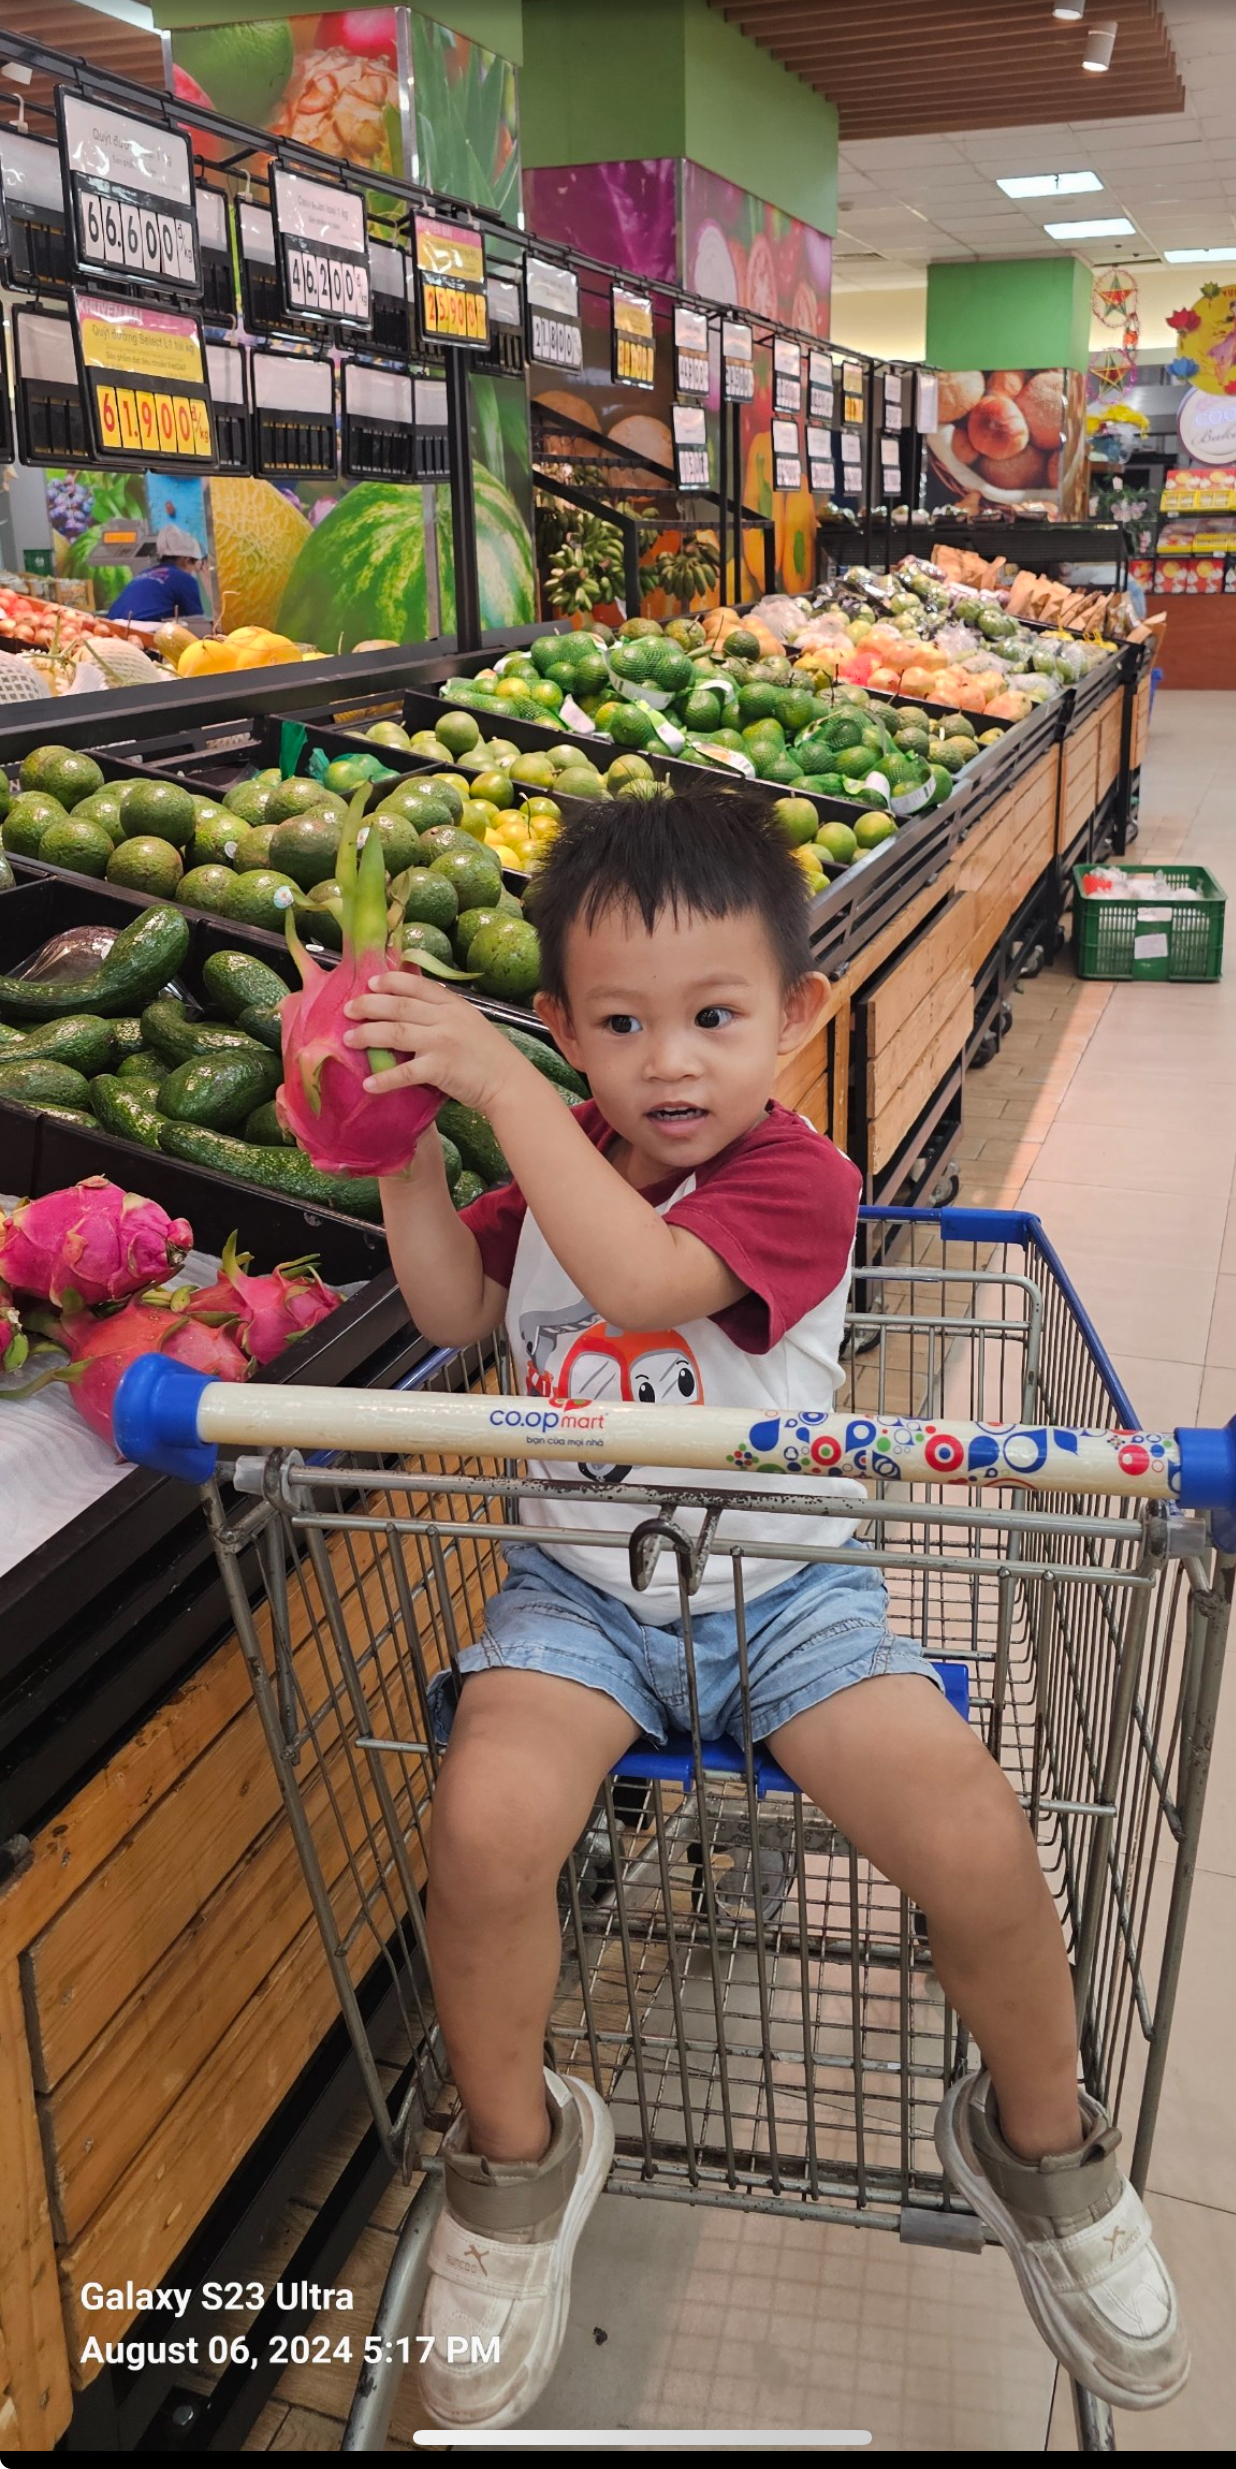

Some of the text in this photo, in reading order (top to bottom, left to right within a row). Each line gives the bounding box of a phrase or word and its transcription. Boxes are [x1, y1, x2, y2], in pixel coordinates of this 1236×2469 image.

[88, 202, 173, 262] 66.600
[292, 258, 354, 301] 46.200
[139, 333, 162, 348] Select
[103, 393, 190, 441] 61.900
[527, 1436, 546, 1445] bạn
[547, 1437, 565, 1446] của
[567, 1439, 584, 1447] mọi
